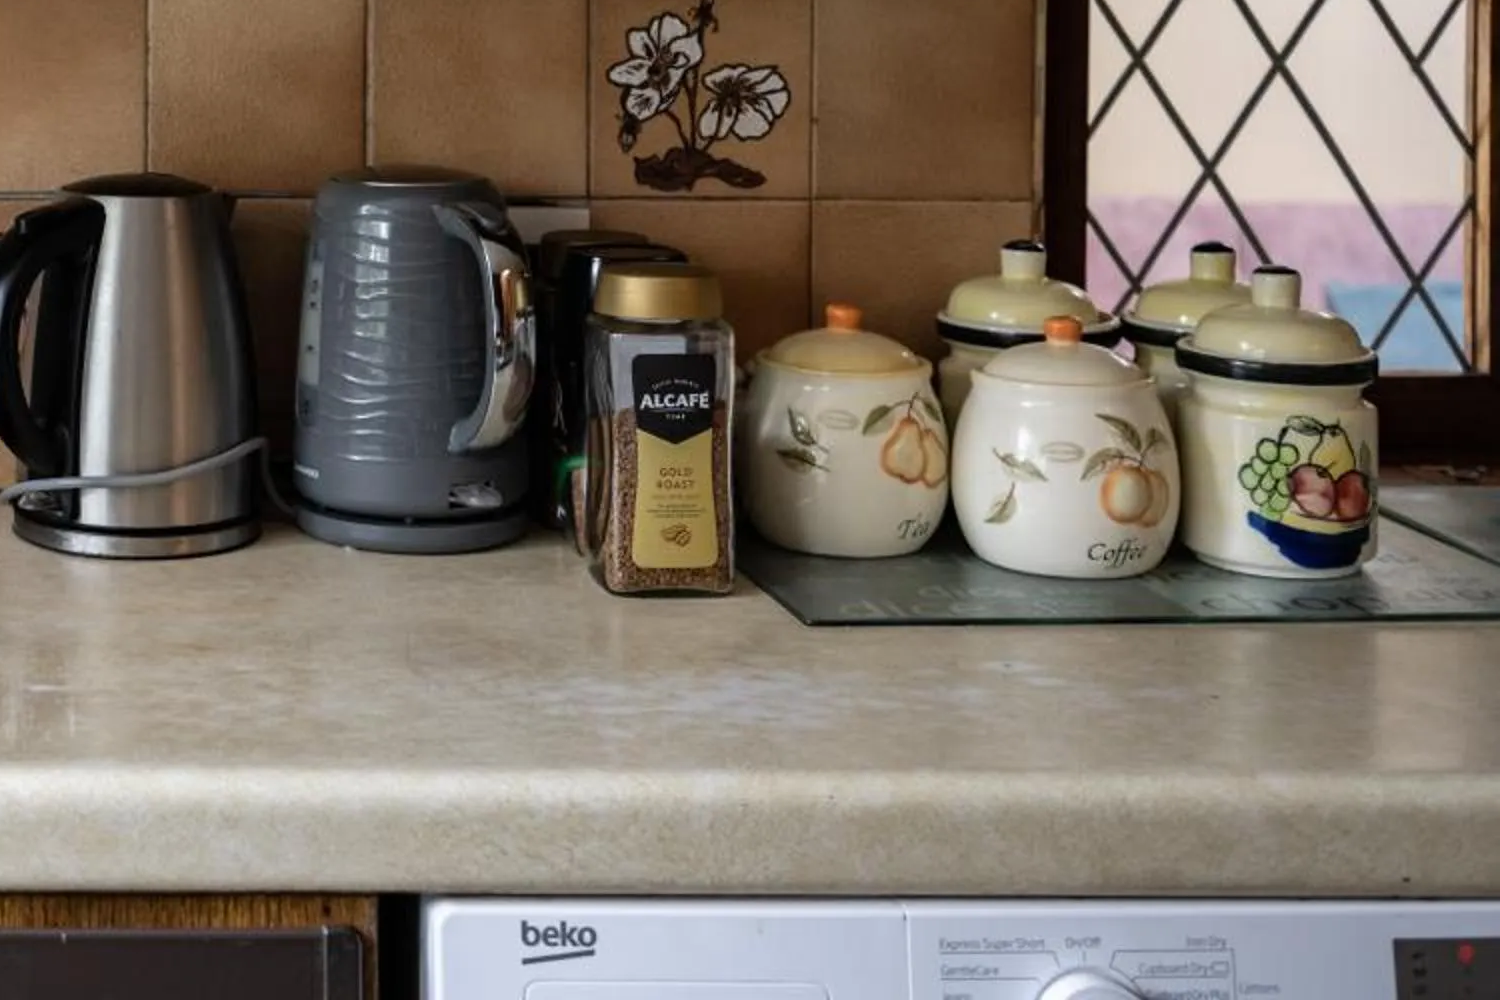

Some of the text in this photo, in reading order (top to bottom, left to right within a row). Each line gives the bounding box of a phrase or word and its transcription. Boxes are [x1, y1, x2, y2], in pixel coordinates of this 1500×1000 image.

[659, 467, 695, 478] GOLD
[656, 479, 697, 490] ROAST
[897, 519, 930, 540] Tea
[1087, 538, 1148, 569] Coffee
[521, 919, 597, 947] beko
